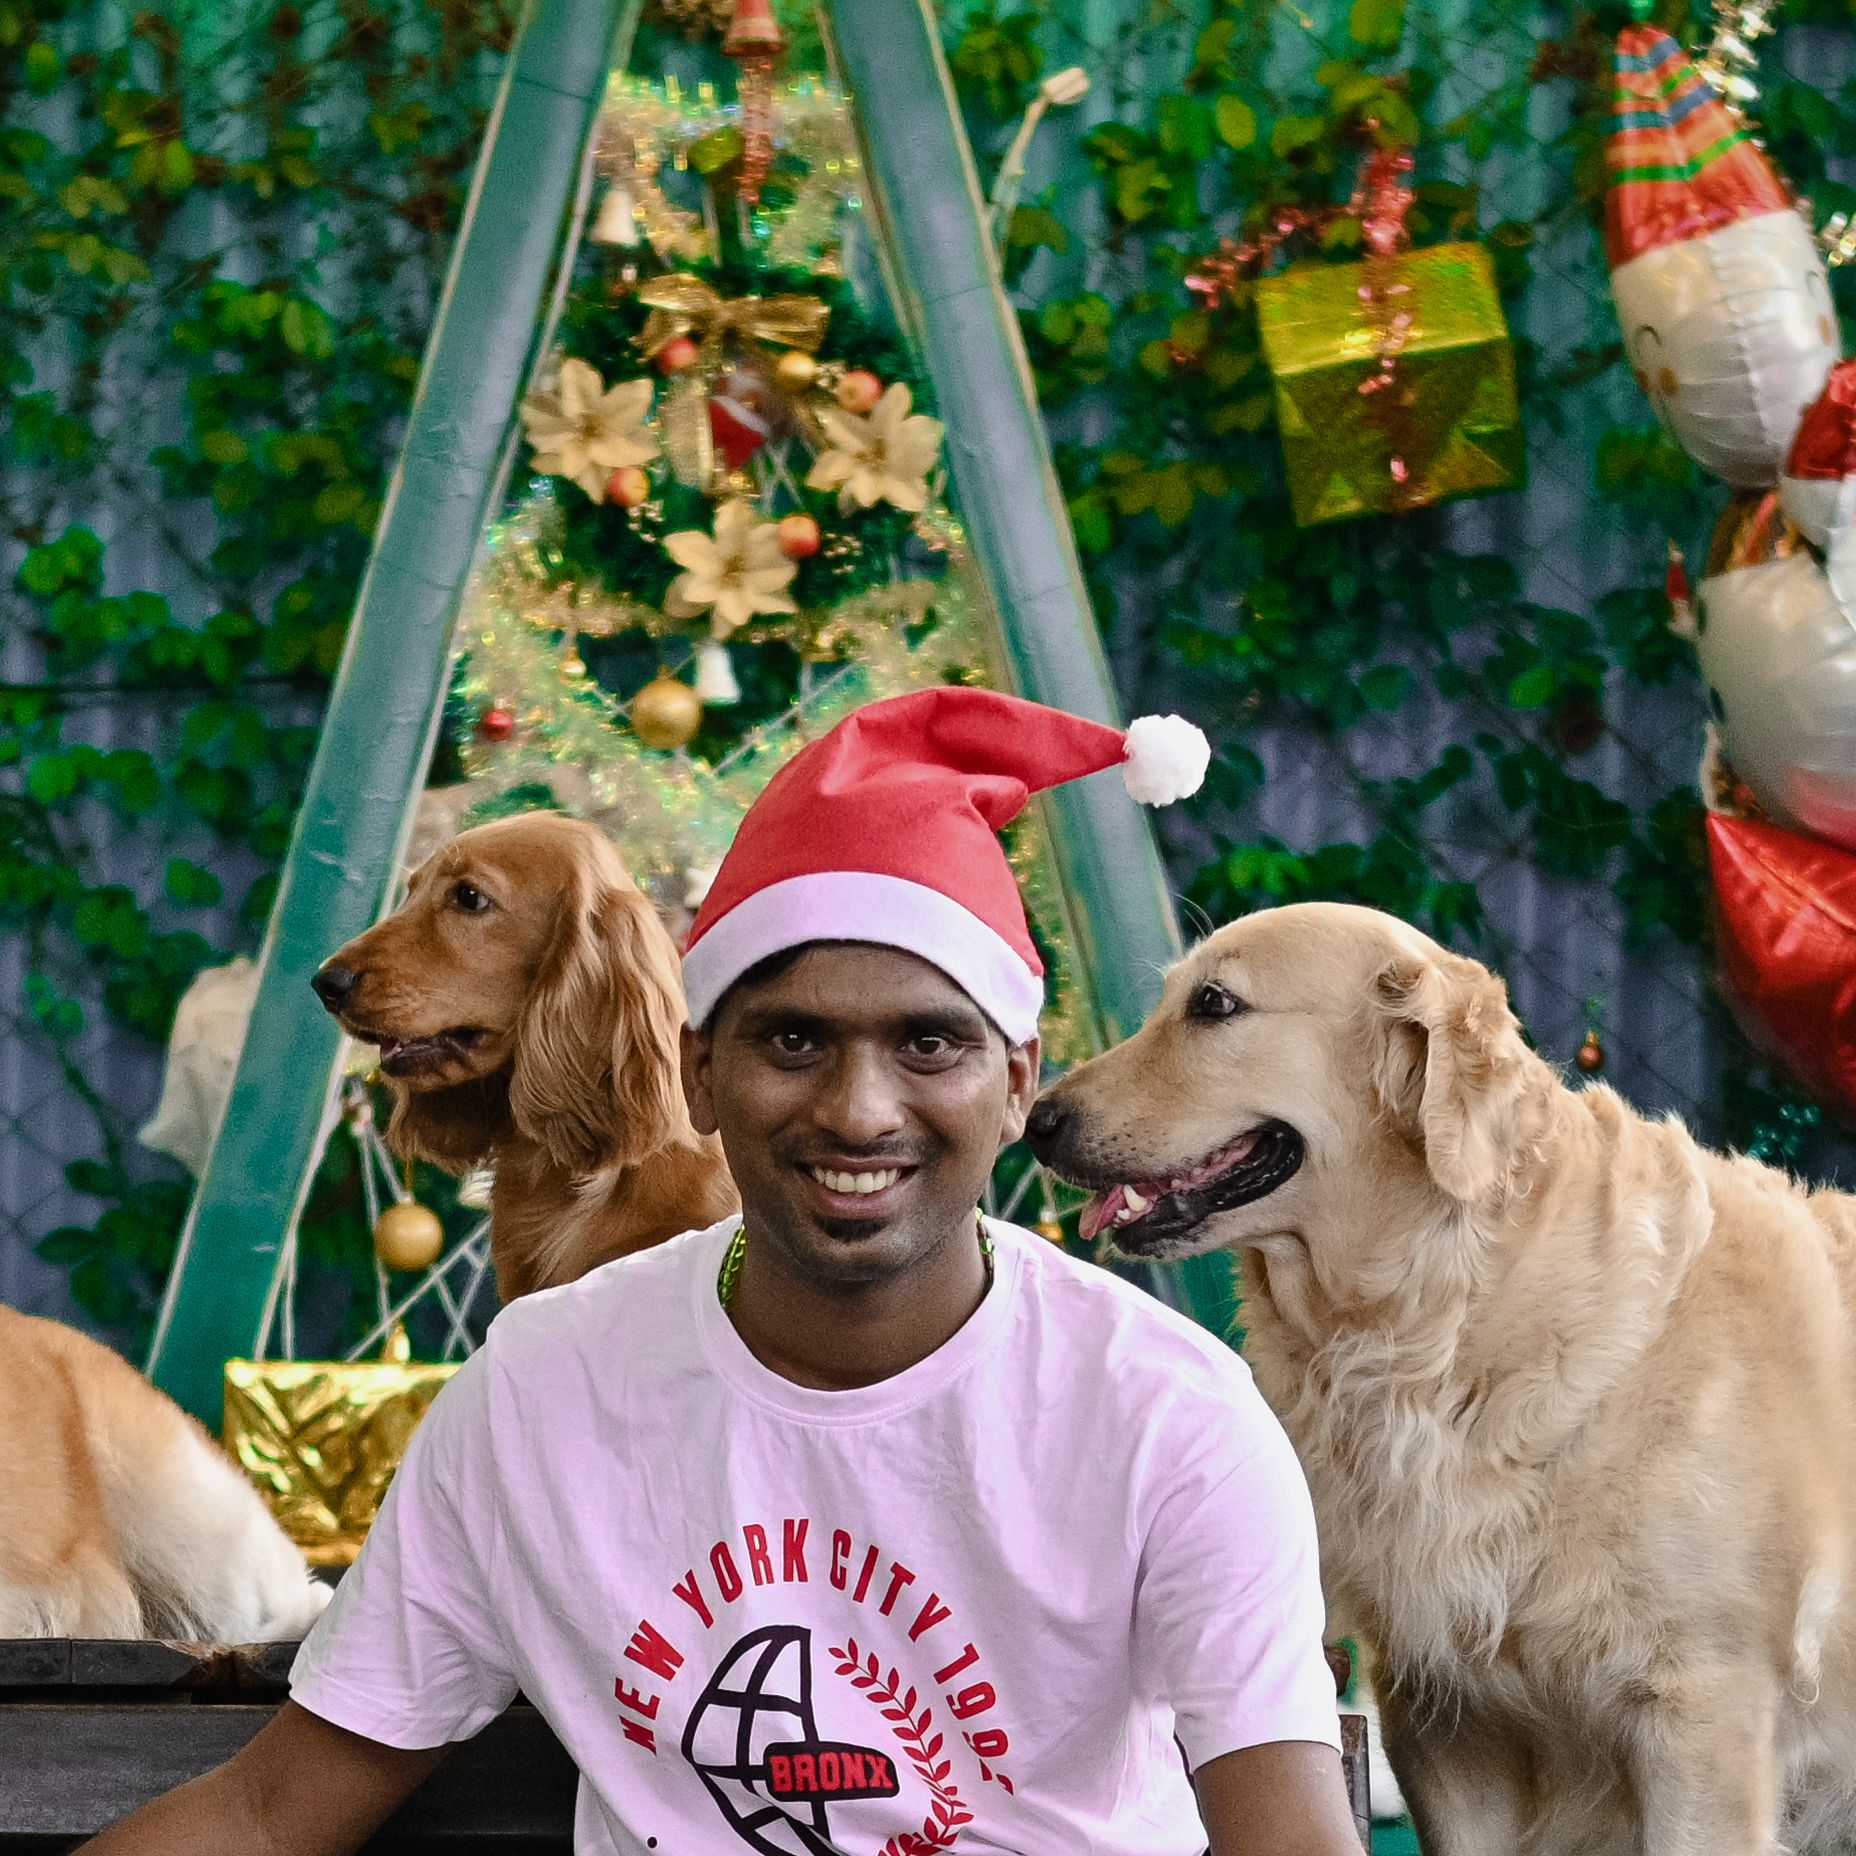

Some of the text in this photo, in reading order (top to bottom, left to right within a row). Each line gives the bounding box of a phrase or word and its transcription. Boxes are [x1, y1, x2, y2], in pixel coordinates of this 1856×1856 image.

[614, 1618, 685, 1757] NEW
[673, 1518, 810, 1628] YORK
[830, 1528, 952, 1642] CITY
[770, 1751, 895, 1793] BRONX
